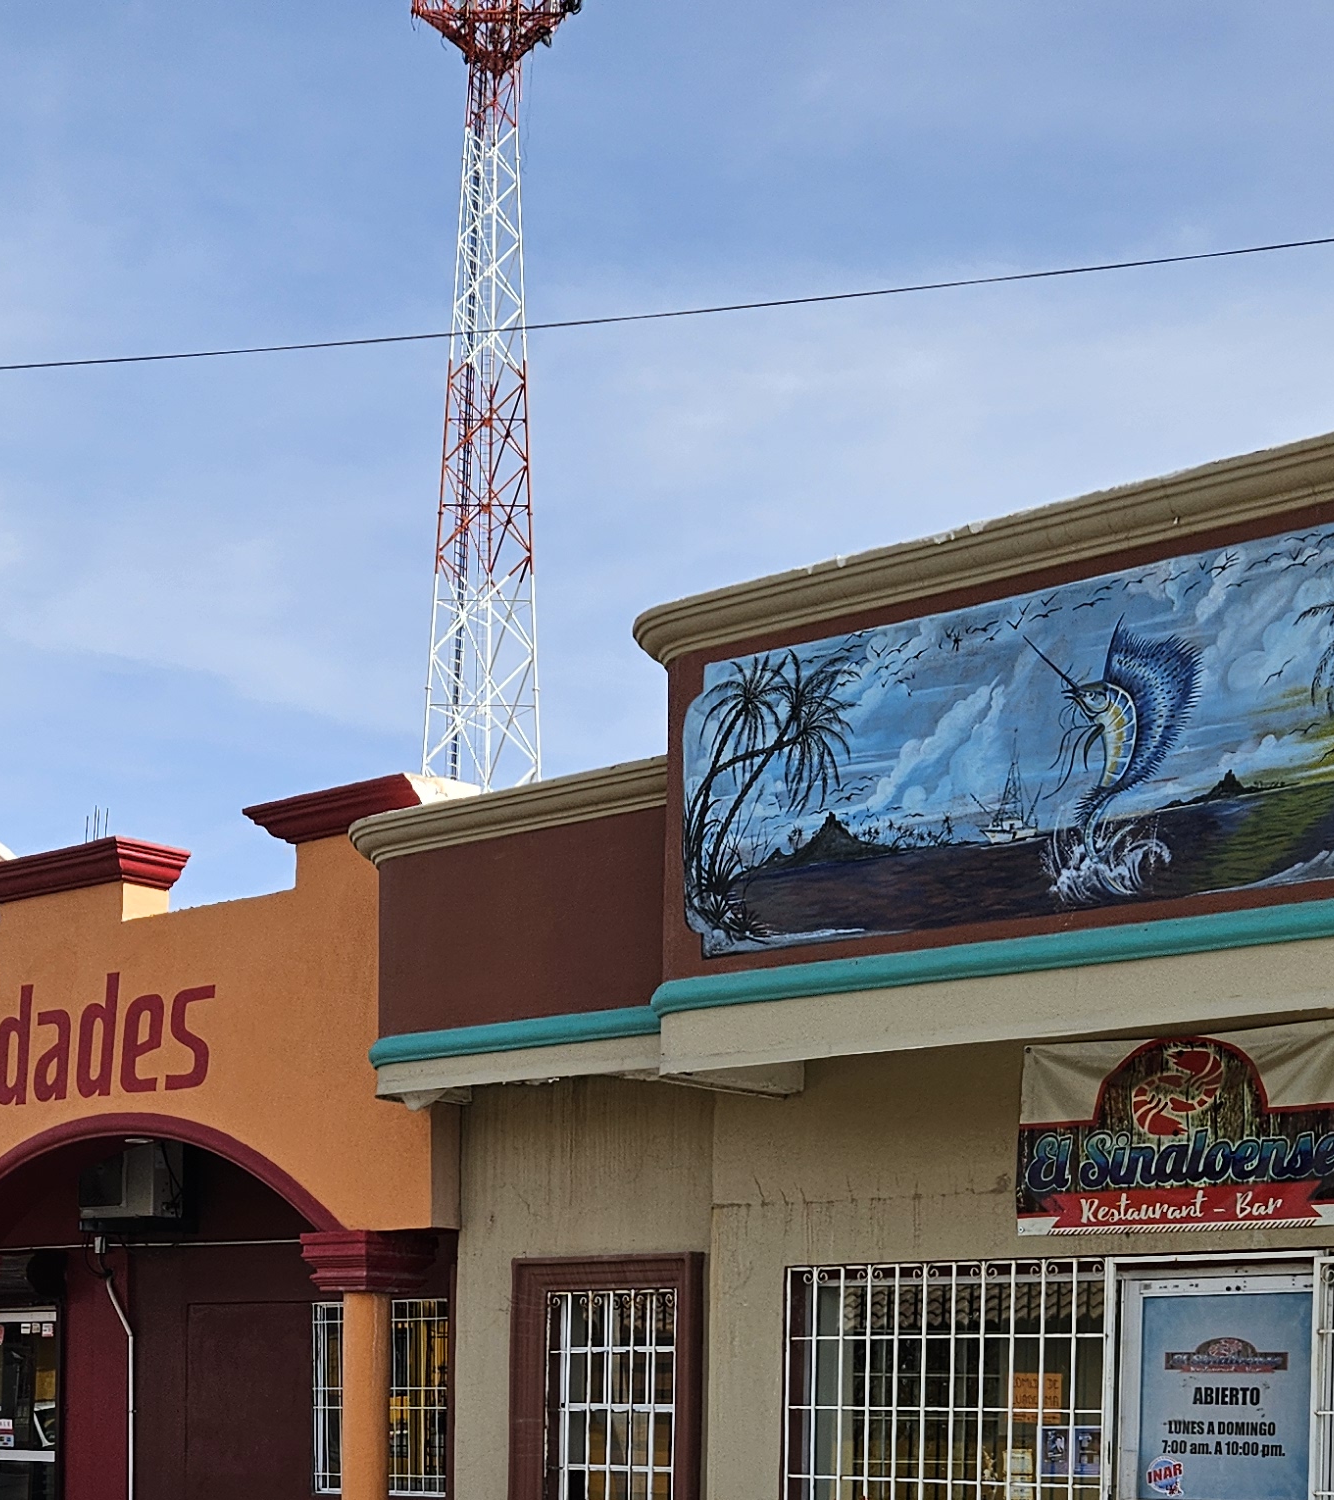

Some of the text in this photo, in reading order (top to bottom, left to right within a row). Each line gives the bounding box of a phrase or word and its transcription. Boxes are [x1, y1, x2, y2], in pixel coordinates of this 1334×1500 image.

[1027, 1132, 1073, 1190] El
[1080, 1191, 1208, 1224] Restaurant
[1235, 1191, 1283, 1218] Bar
[1192, 1387, 1260, 1406] ABIERTO
[1168, 1420, 1276, 1436] LUNES A DOMINGO
[1162, 1440, 1285, 1458] 7:00 am. A 10:00 pm.
[1147, 1463, 1182, 1484] INAR
